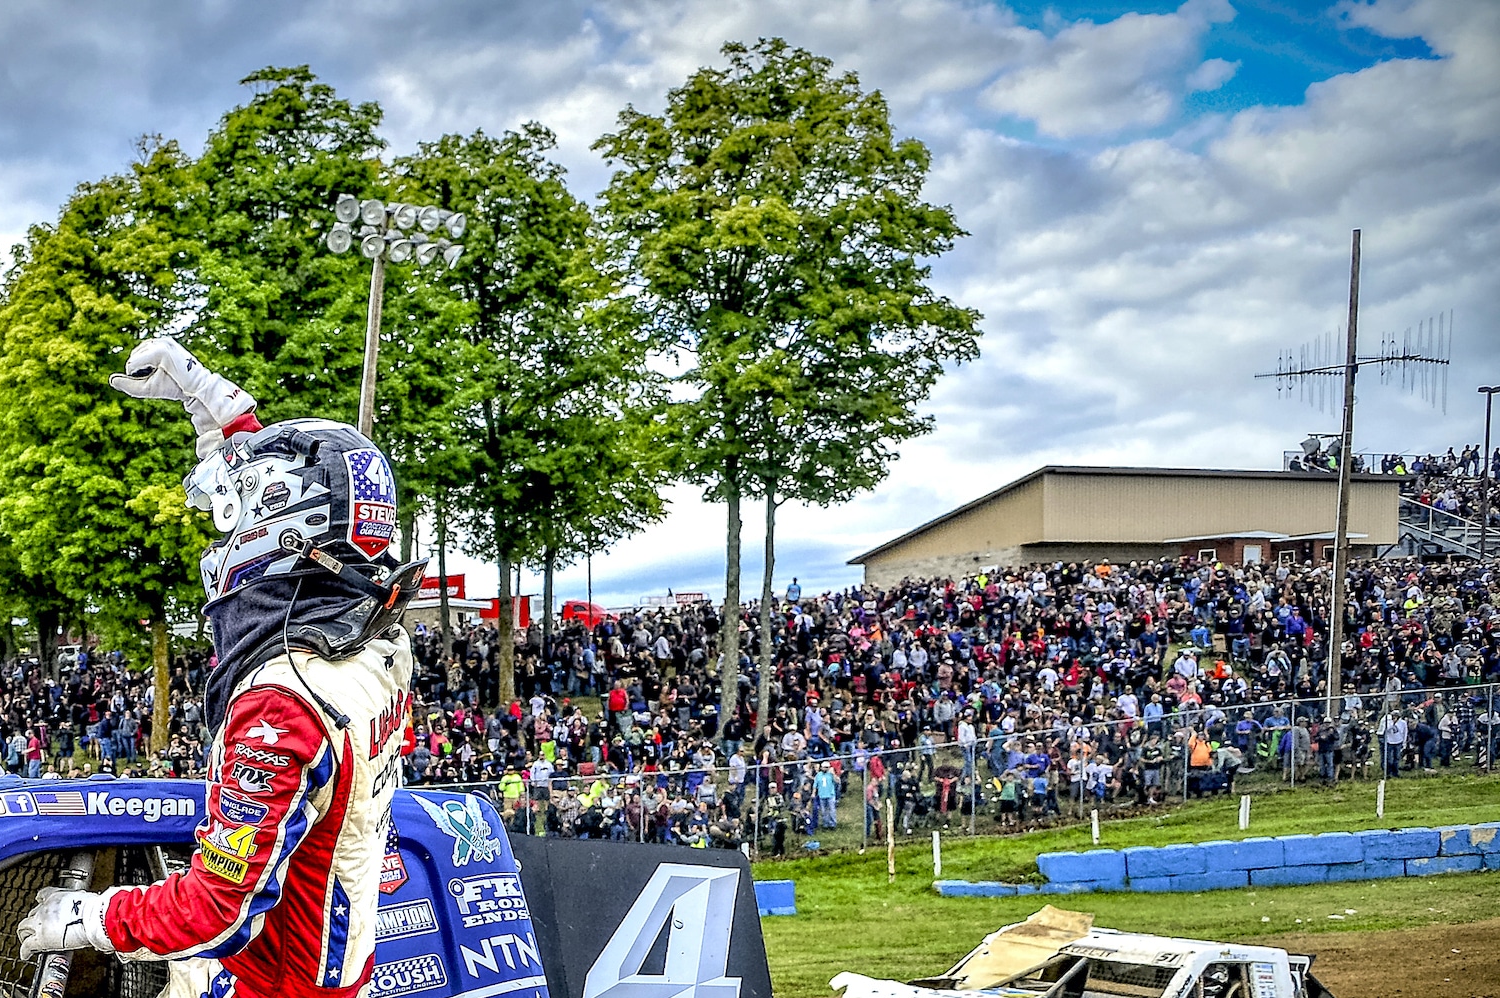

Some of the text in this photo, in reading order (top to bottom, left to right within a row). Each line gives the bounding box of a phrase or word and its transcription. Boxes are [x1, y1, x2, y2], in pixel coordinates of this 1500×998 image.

[364, 456, 387, 496] 4
[358, 504, 395, 522] STEVE
[231, 762, 276, 792] FOX
[87, 792, 195, 822] Keegan
[462, 908, 530, 928] ENDS
[476, 897, 525, 913] ROD
[460, 932, 541, 979] NTN
[369, 965, 441, 994] ROUSH
